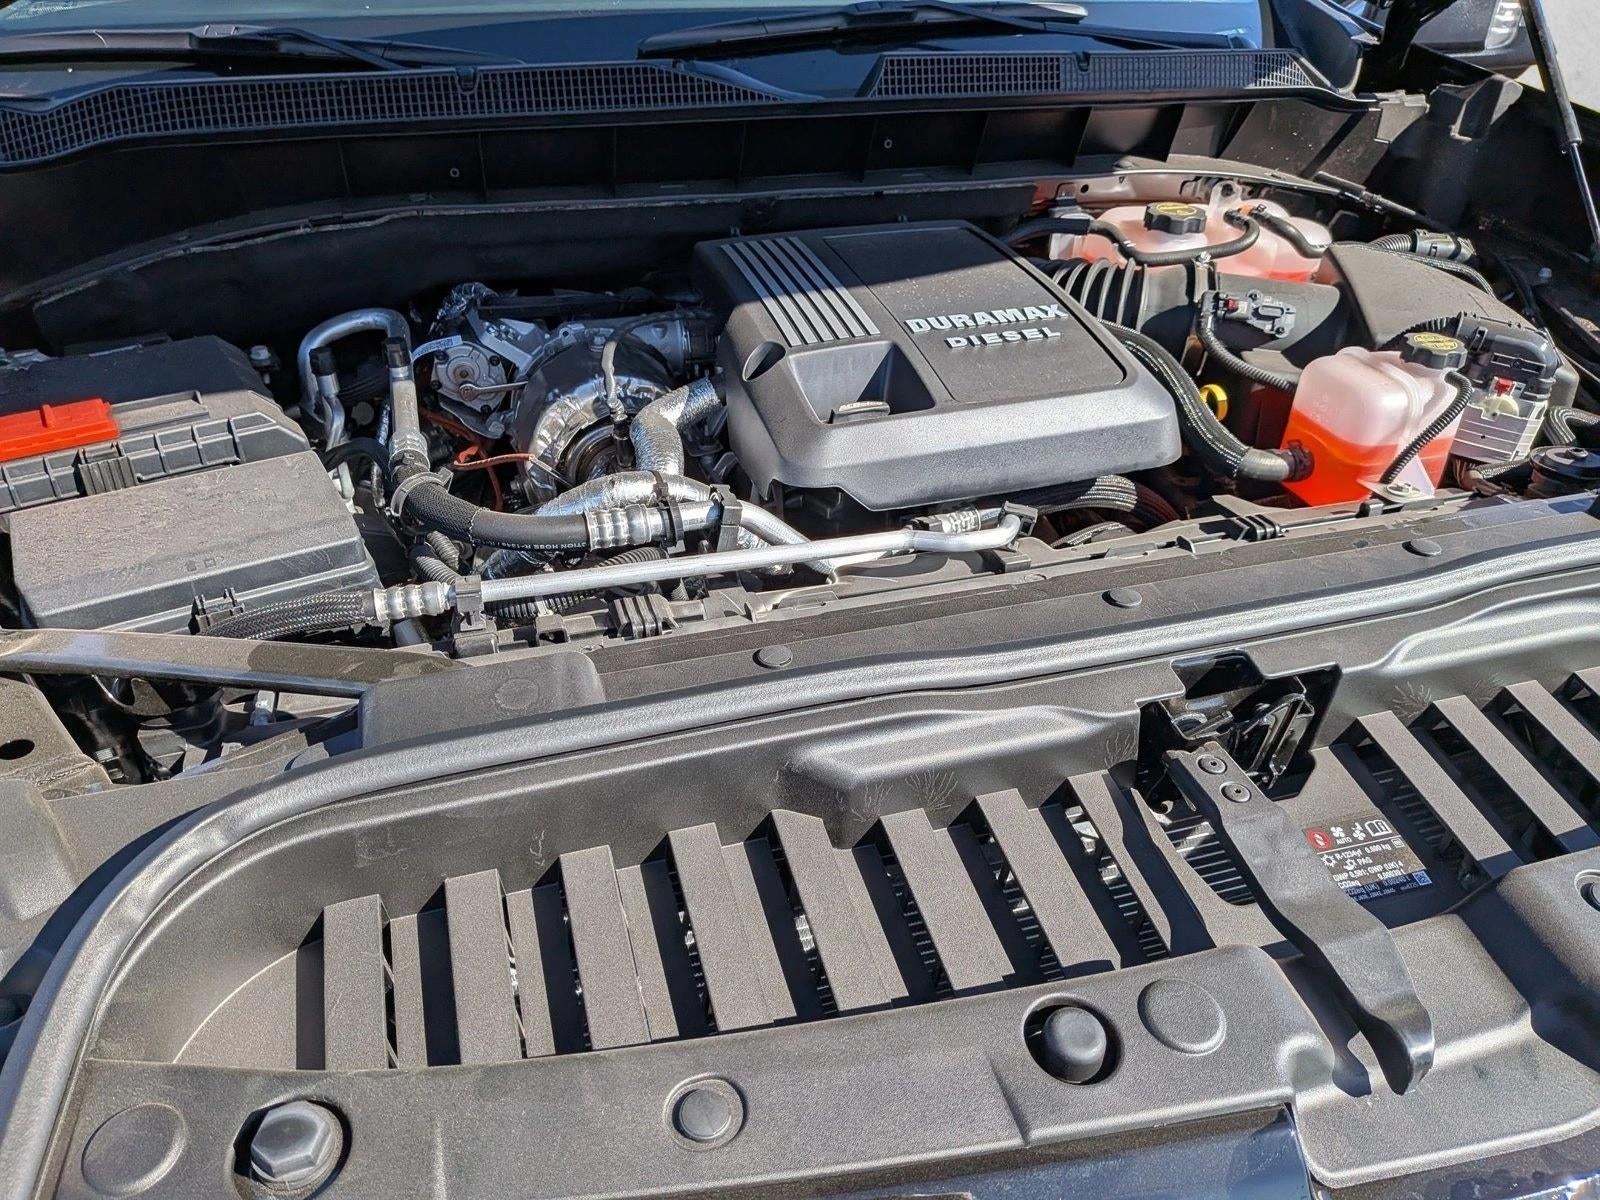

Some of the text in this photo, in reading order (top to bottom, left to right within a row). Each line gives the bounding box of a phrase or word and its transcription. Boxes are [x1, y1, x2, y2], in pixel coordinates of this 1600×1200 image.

[905, 304, 1068, 333] DURAMAX
[945, 326, 1061, 348] DIESEL
[1336, 836, 1352, 845] AUTO
[1334, 848, 1363, 860] R-1234yf
[1356, 856, 1373, 865] PAG
[1332, 872, 1349, 882] GWP
[1368, 865, 1384, 874] GWP
[1384, 861, 1399, 871] (UK)
